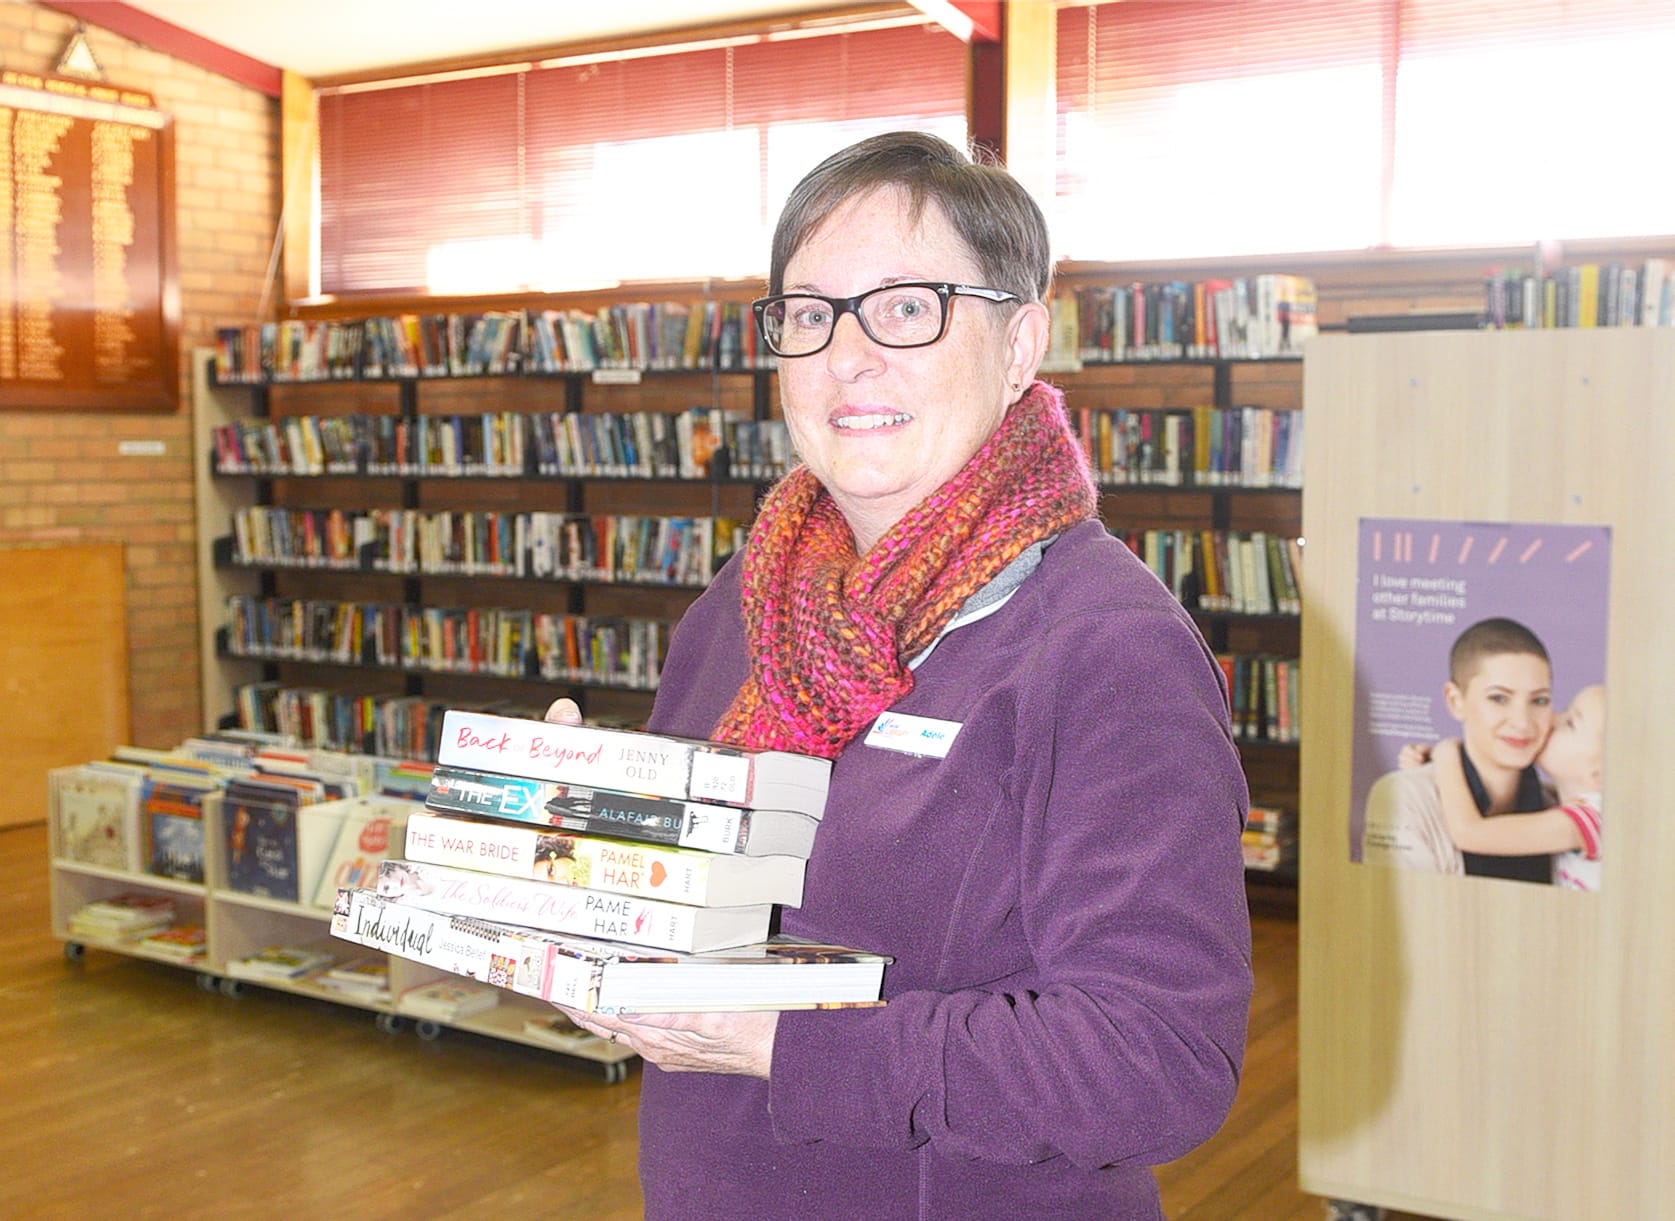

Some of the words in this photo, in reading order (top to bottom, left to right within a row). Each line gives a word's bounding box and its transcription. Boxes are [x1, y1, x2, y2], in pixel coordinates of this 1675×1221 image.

[1380, 575, 1408, 589] love
[1409, 577, 1467, 596] meeting
[1372, 591, 1408, 606] other
[1410, 591, 1467, 609] families
[1372, 606, 1387, 621] at
[1388, 606, 1457, 626] Storytime
[456, 726, 512, 753] Back
[528, 736, 604, 769] Beyond
[617, 747, 671, 766] JENNY
[625, 765, 658, 782] OLD
[457, 783, 494, 807] THE
[497, 783, 543, 818] EX
[410, 831, 436, 849] THE
[440, 834, 475, 855] WAR
[479, 841, 521, 863] BRIDE
[684, 867, 694, 894] HART
[438, 878, 468, 903] The
[532, 892, 579, 922] Wife
[352, 904, 436, 958] Individual
[668, 914, 679, 942] HART
